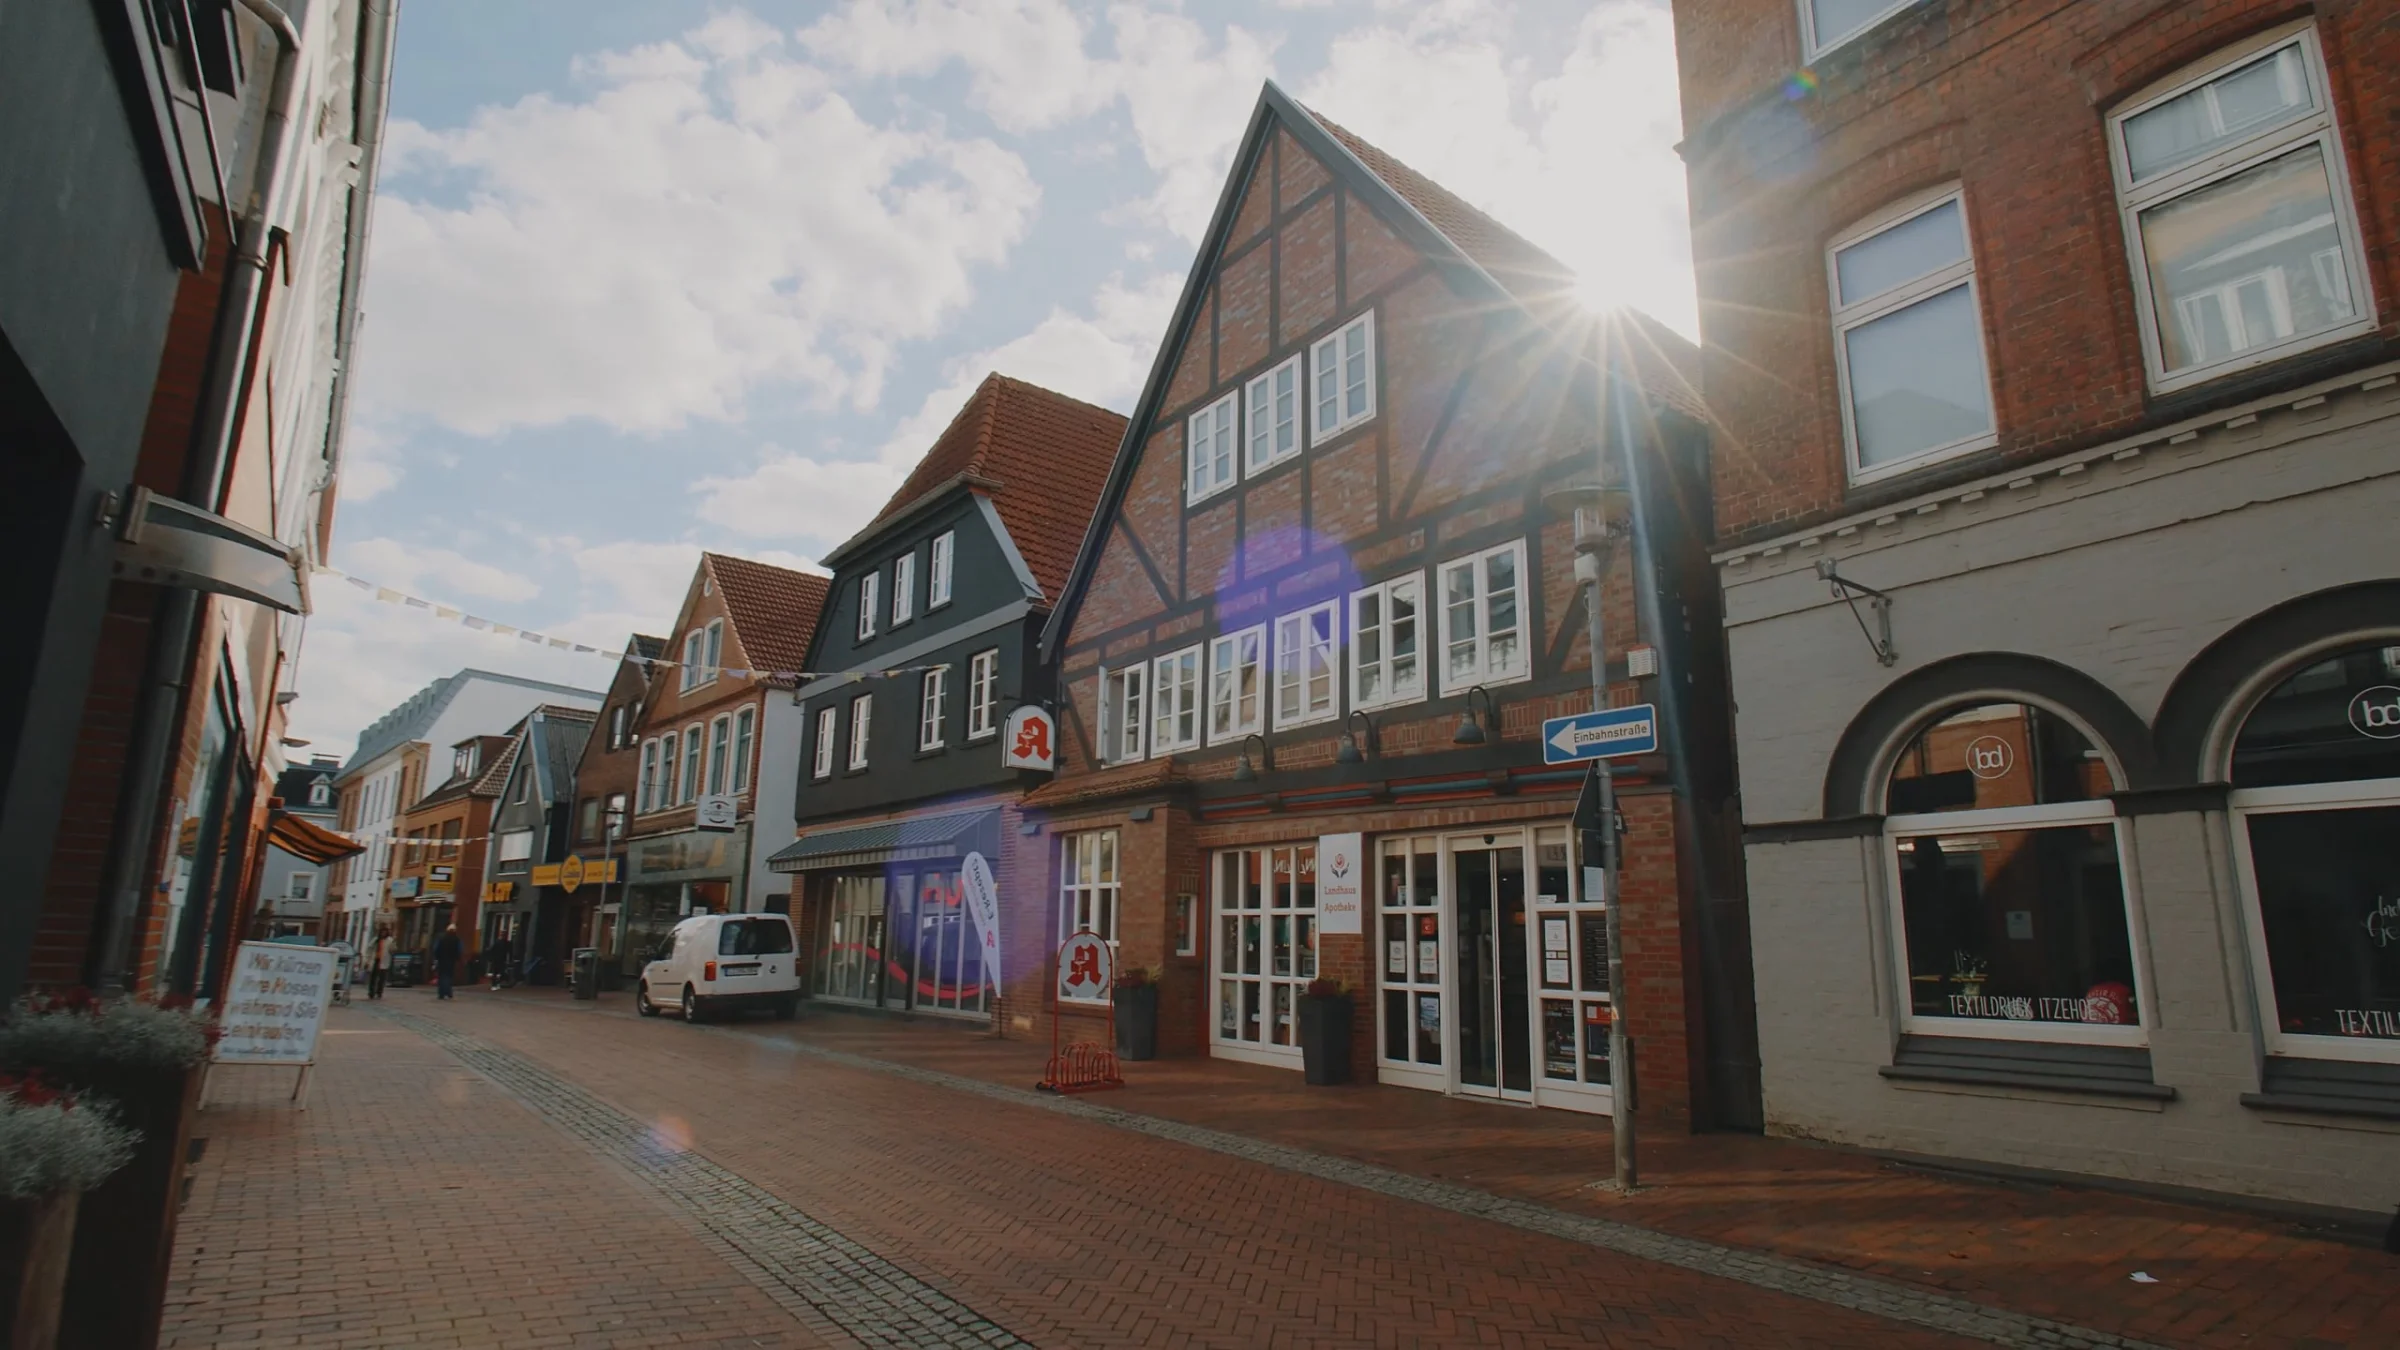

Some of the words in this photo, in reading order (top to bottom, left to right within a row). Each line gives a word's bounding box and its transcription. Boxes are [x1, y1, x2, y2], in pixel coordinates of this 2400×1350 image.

[1573, 723, 1648, 744] Einbahnstraße
[1974, 744, 2004, 770] bd
[1324, 885, 1357, 895] Landhaus
[1324, 901, 1357, 914] Apotheke
[295, 1001, 319, 1019] Sie
[1948, 994, 2032, 1019] TEXTILDRUCK
[2038, 997, 2098, 1021] ITZEHOE
[2334, 1009, 2400, 1036] TEXTIL
